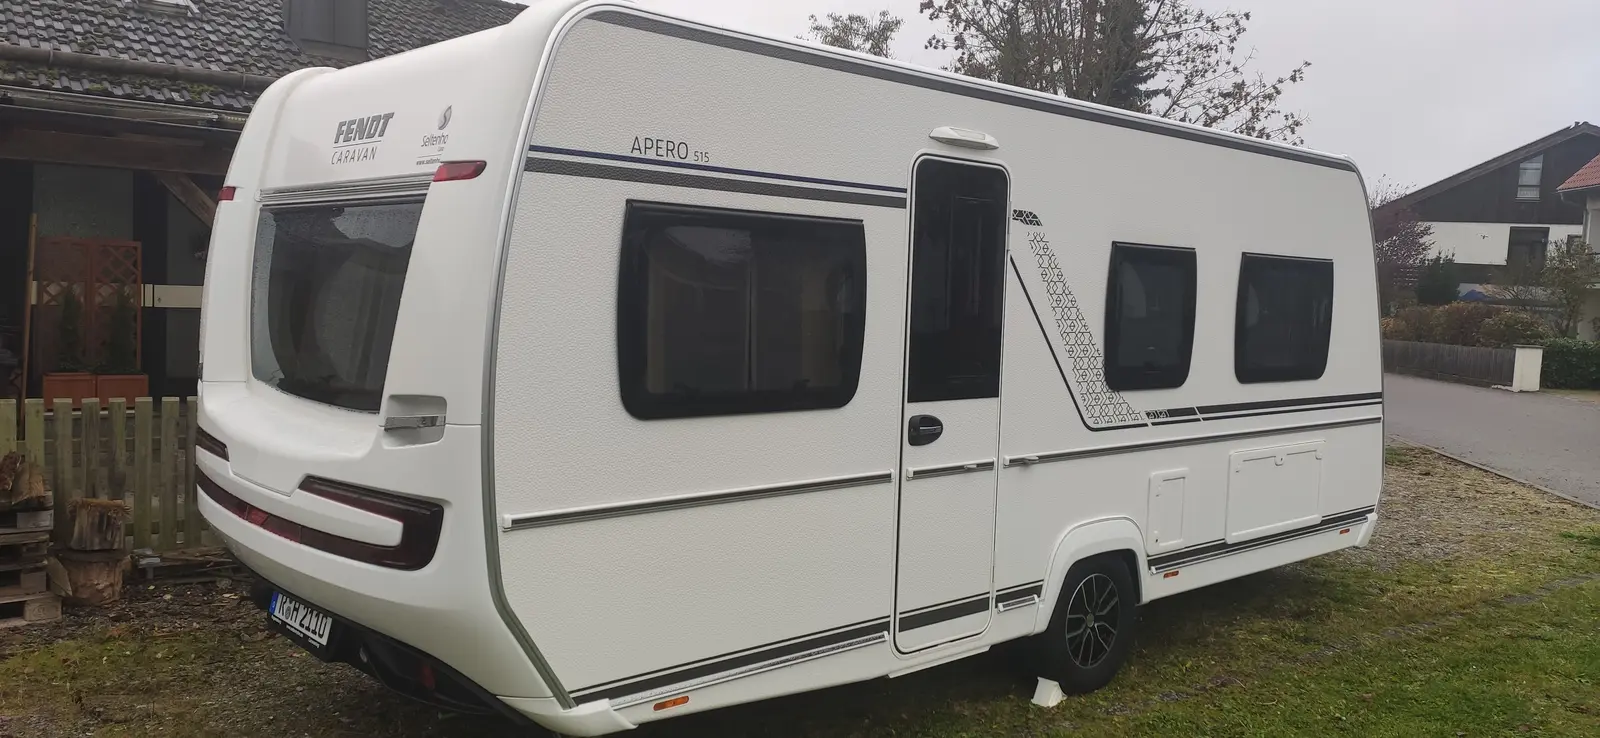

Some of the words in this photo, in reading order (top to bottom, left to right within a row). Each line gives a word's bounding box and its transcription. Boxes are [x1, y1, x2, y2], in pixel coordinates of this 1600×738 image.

[334, 112, 395, 143] FENDT
[331, 146, 378, 165] CARAVAN
[631, 136, 688, 159] APERO
[693, 150, 710, 163] 515
